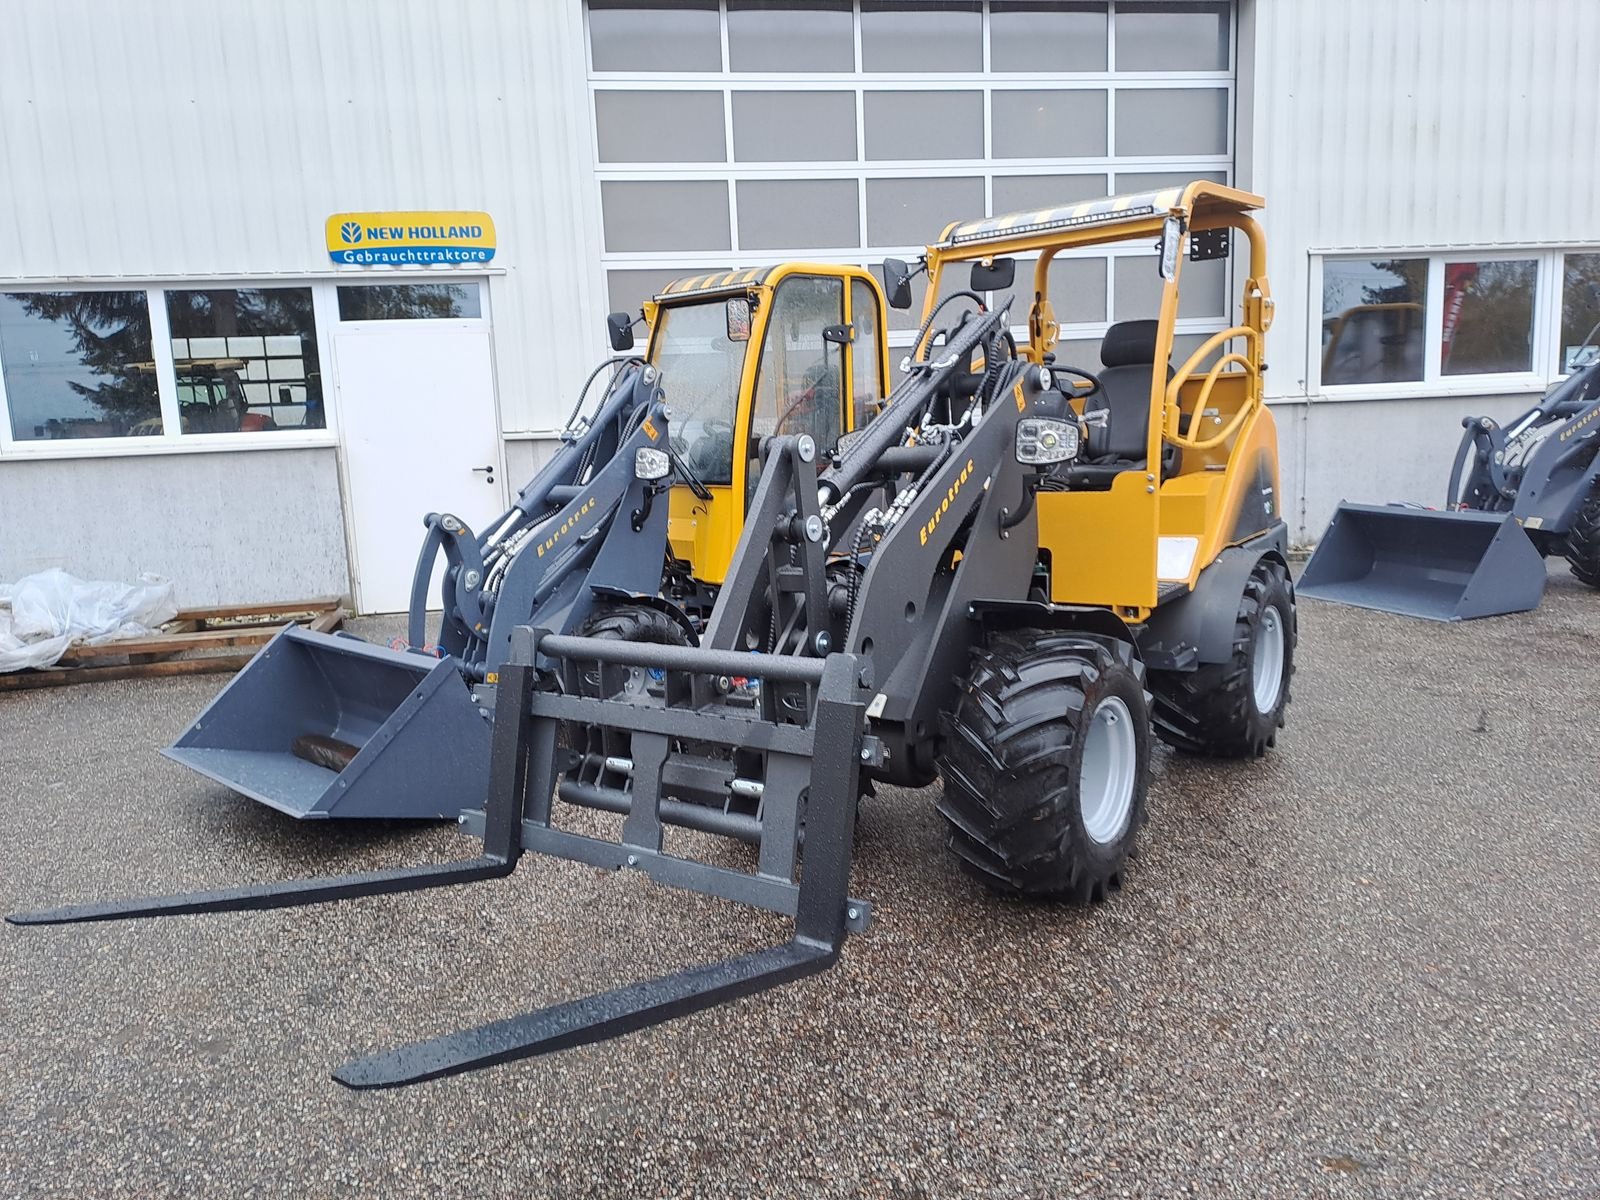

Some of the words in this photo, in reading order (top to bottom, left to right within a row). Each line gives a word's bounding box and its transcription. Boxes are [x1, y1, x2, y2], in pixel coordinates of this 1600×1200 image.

[366, 226, 404, 240] NEW
[408, 225, 482, 240] HOLLAND
[343, 249, 486, 263] Gebrauchttraktore
[1560, 406, 1600, 442] Eurotra
[919, 458, 974, 546] Eurotrac
[536, 496, 596, 558] Eurotrac
